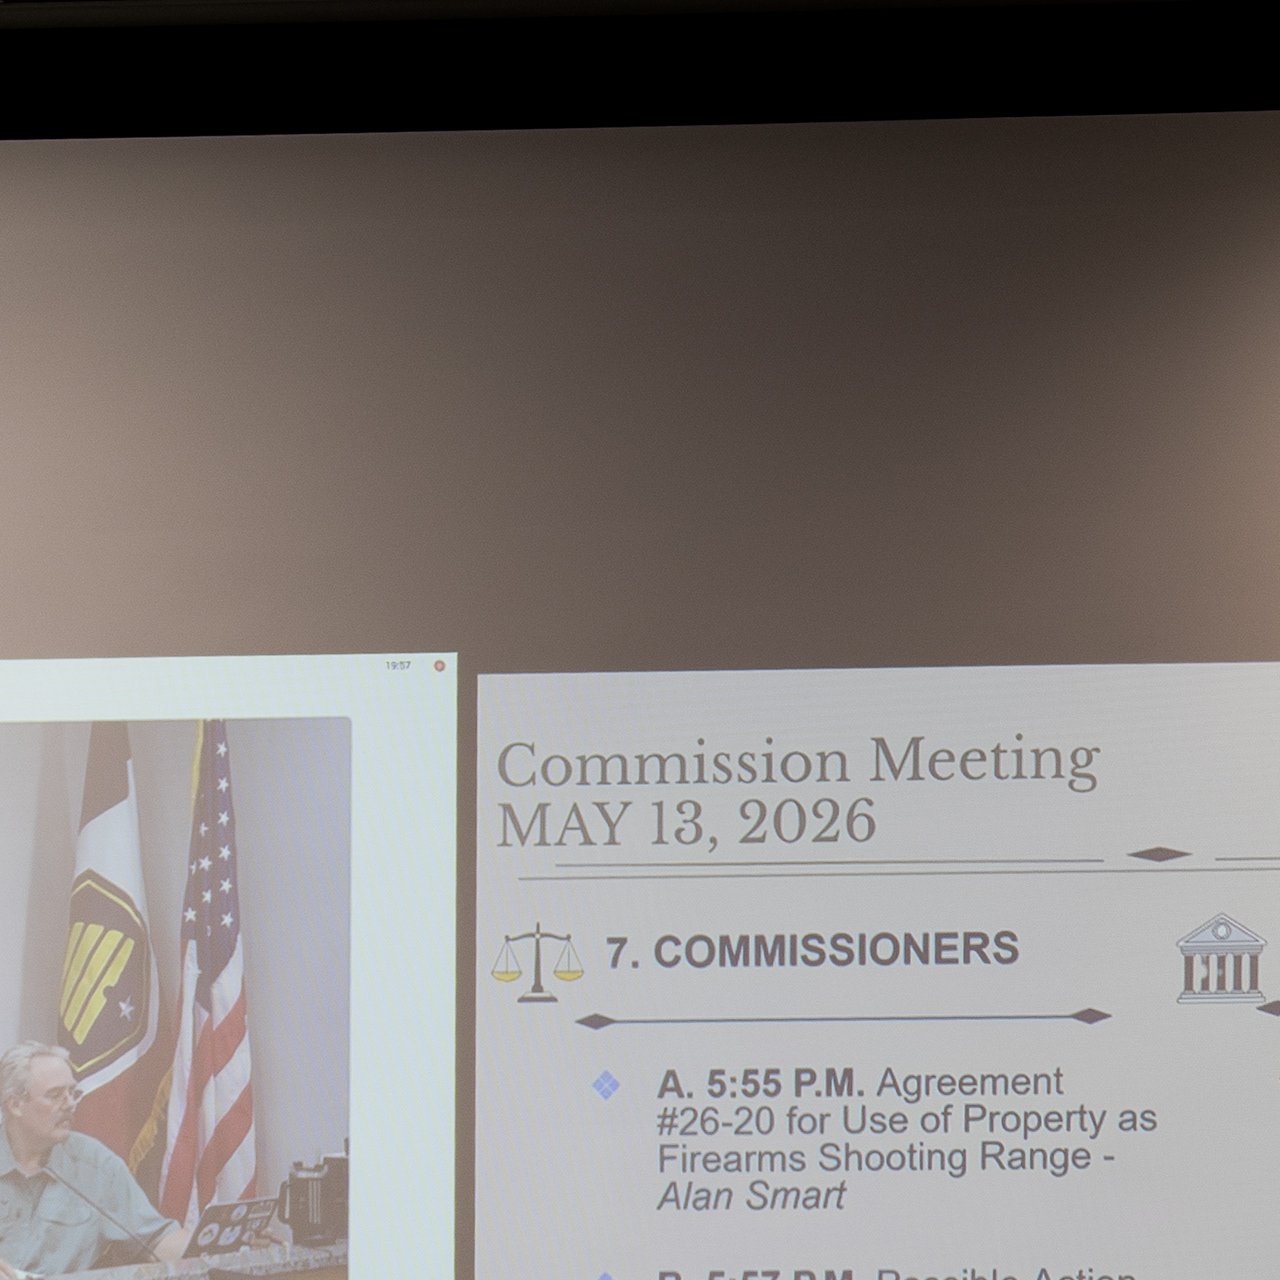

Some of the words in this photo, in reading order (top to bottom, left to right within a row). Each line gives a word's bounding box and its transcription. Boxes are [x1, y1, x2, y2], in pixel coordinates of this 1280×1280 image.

[498, 736, 851, 787] Commission
[870, 733, 1101, 793] Meeting
[498, 800, 633, 847] MAY
[652, 799, 718, 853] 13,
[739, 797, 876, 844] 2026
[606, 936, 639, 969] 7.
[654, 930, 1019, 969] COMMISSIONERS
[657, 1069, 694, 1099] A.
[707, 1068, 782, 1099] 5:55
[794, 1067, 865, 1098] P.M.
[876, 1067, 1064, 1105] Agreement
[657, 1105, 775, 1136] #26-20
[786, 1105, 831, 1135] for
[843, 1104, 909, 1135] Use
[920, 1103, 954, 1134] of
[964, 1103, 1107, 1140] Property
[1118, 1109, 1158, 1132] as
[659, 1143, 807, 1173] Firearms
[818, 1141, 967, 1179] Shooting
[980, 1140, 1092, 1178] Range
[656, 1181, 734, 1212] Alan
[746, 1179, 848, 1211] Smart
